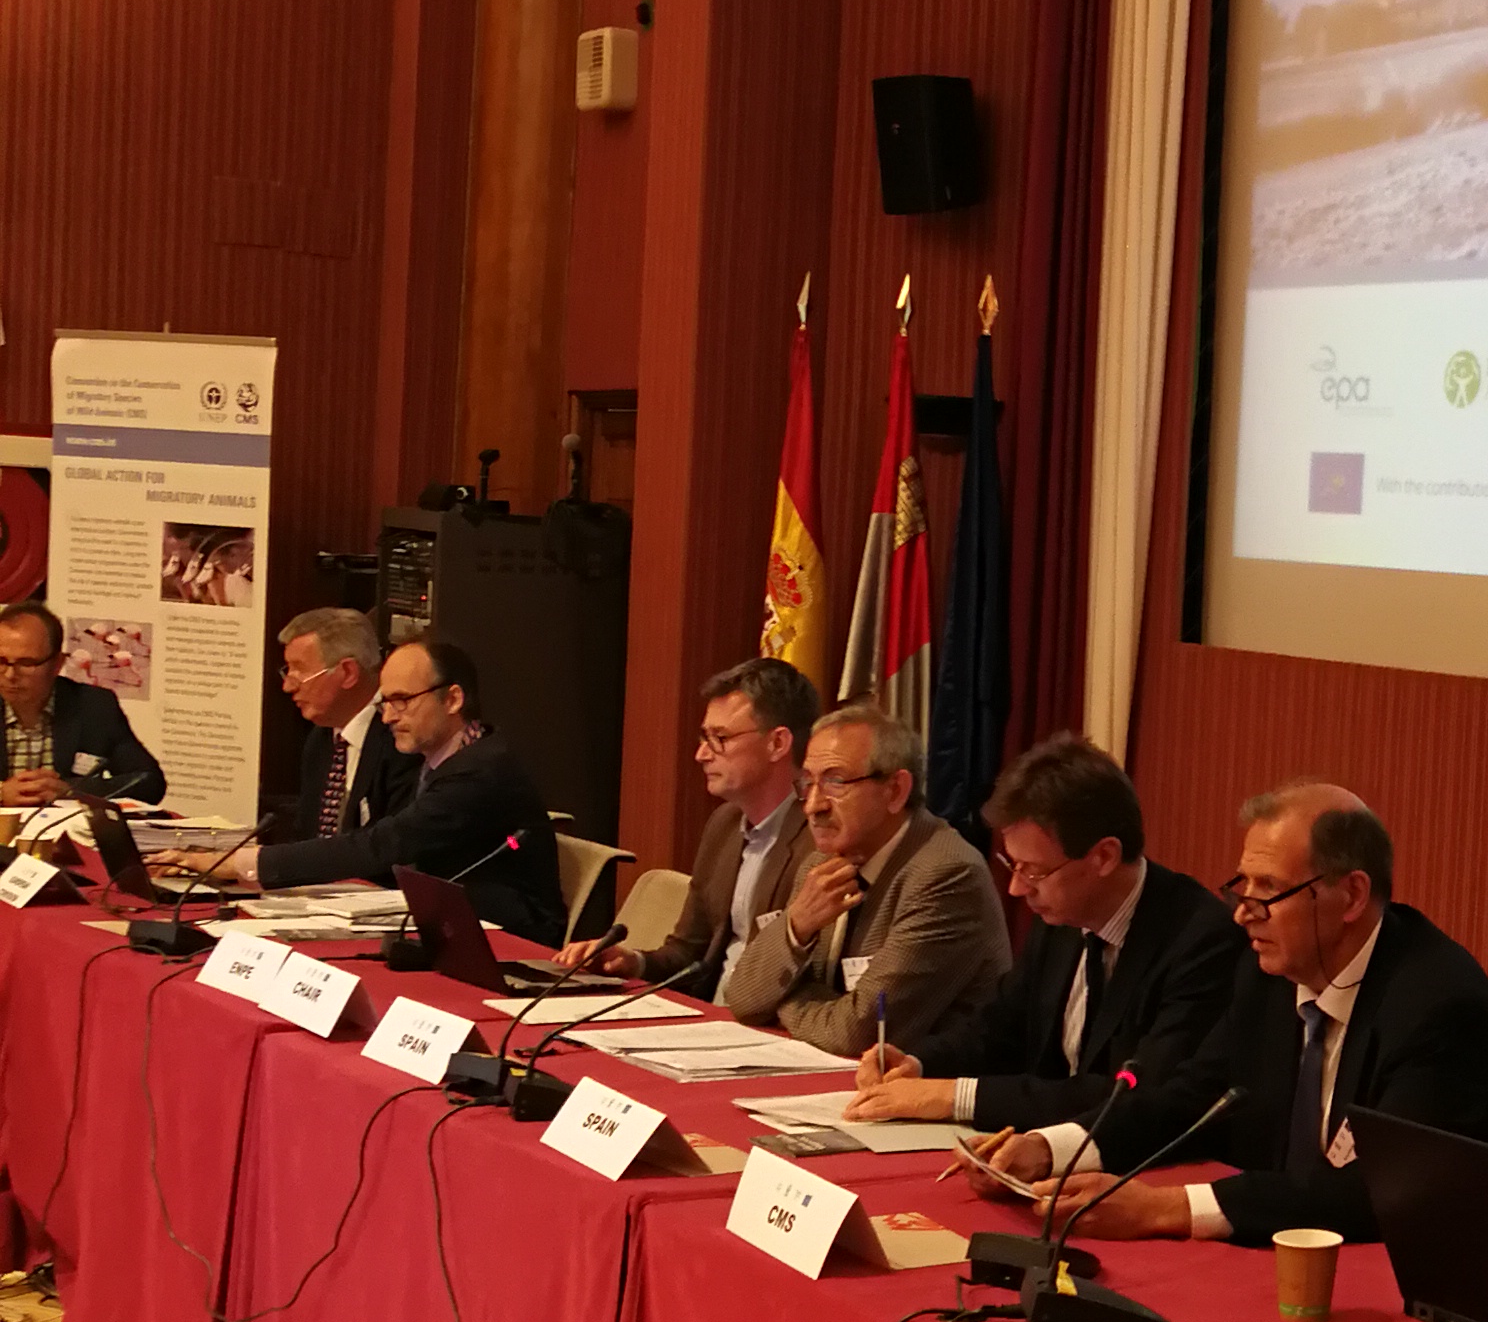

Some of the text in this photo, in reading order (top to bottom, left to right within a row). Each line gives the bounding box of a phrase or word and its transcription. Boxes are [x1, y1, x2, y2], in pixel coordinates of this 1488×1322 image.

[1320, 375, 1371, 411] epa
[228, 960, 256, 981] ENPE
[292, 980, 323, 1004] CHAIR
[397, 1032, 432, 1056] SPAIN
[581, 1112, 619, 1139] SPAIN
[766, 1204, 797, 1234] CMS
